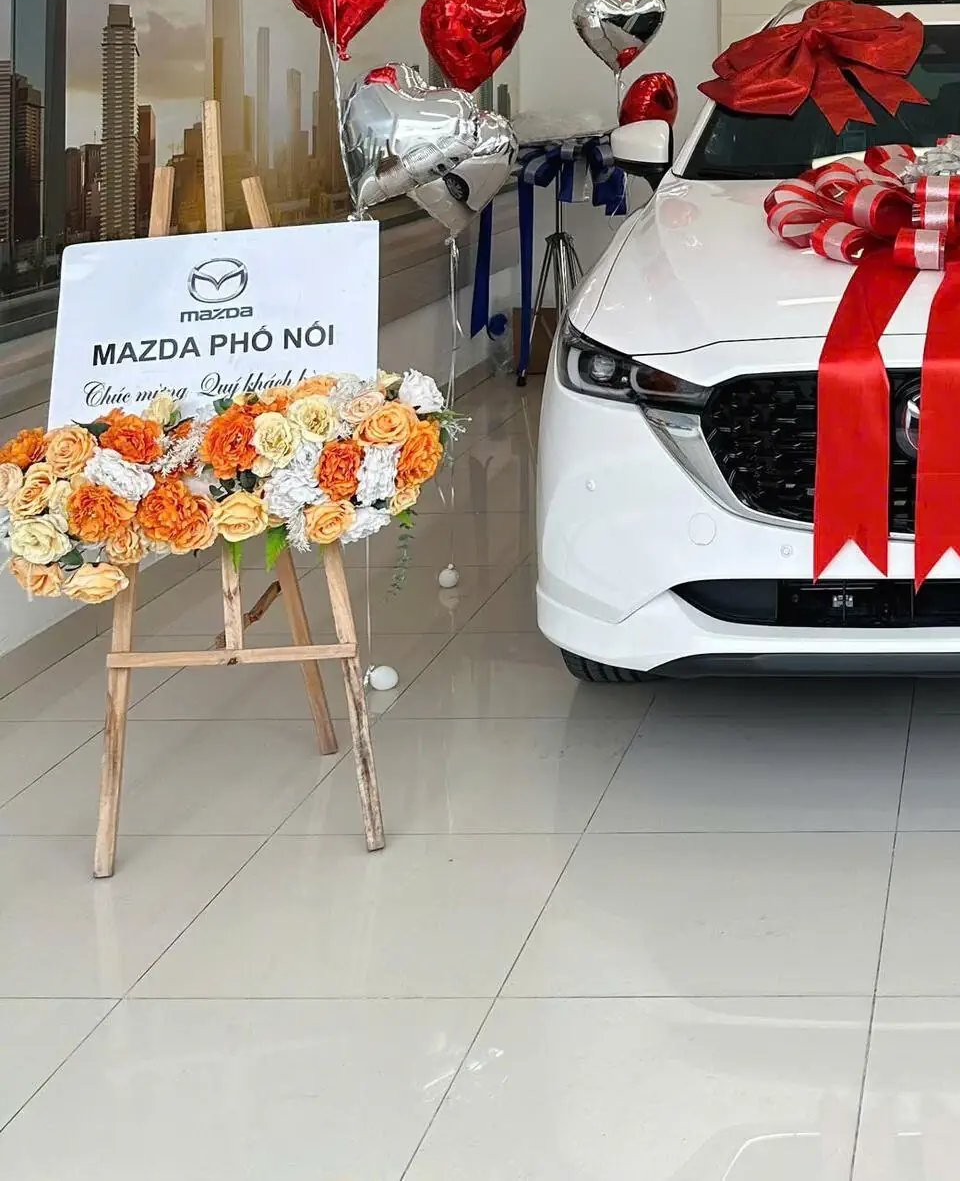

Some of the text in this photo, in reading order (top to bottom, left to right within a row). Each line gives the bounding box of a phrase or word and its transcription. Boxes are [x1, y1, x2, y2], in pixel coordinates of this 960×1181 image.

[180, 306, 253, 323] mazda
[93, 320, 334, 366] MAZDA PHỐ NỐI
[83, 381, 131, 407] Chúc
[199, 371, 243, 399] Quý
[242, 369, 293, 392] khách
